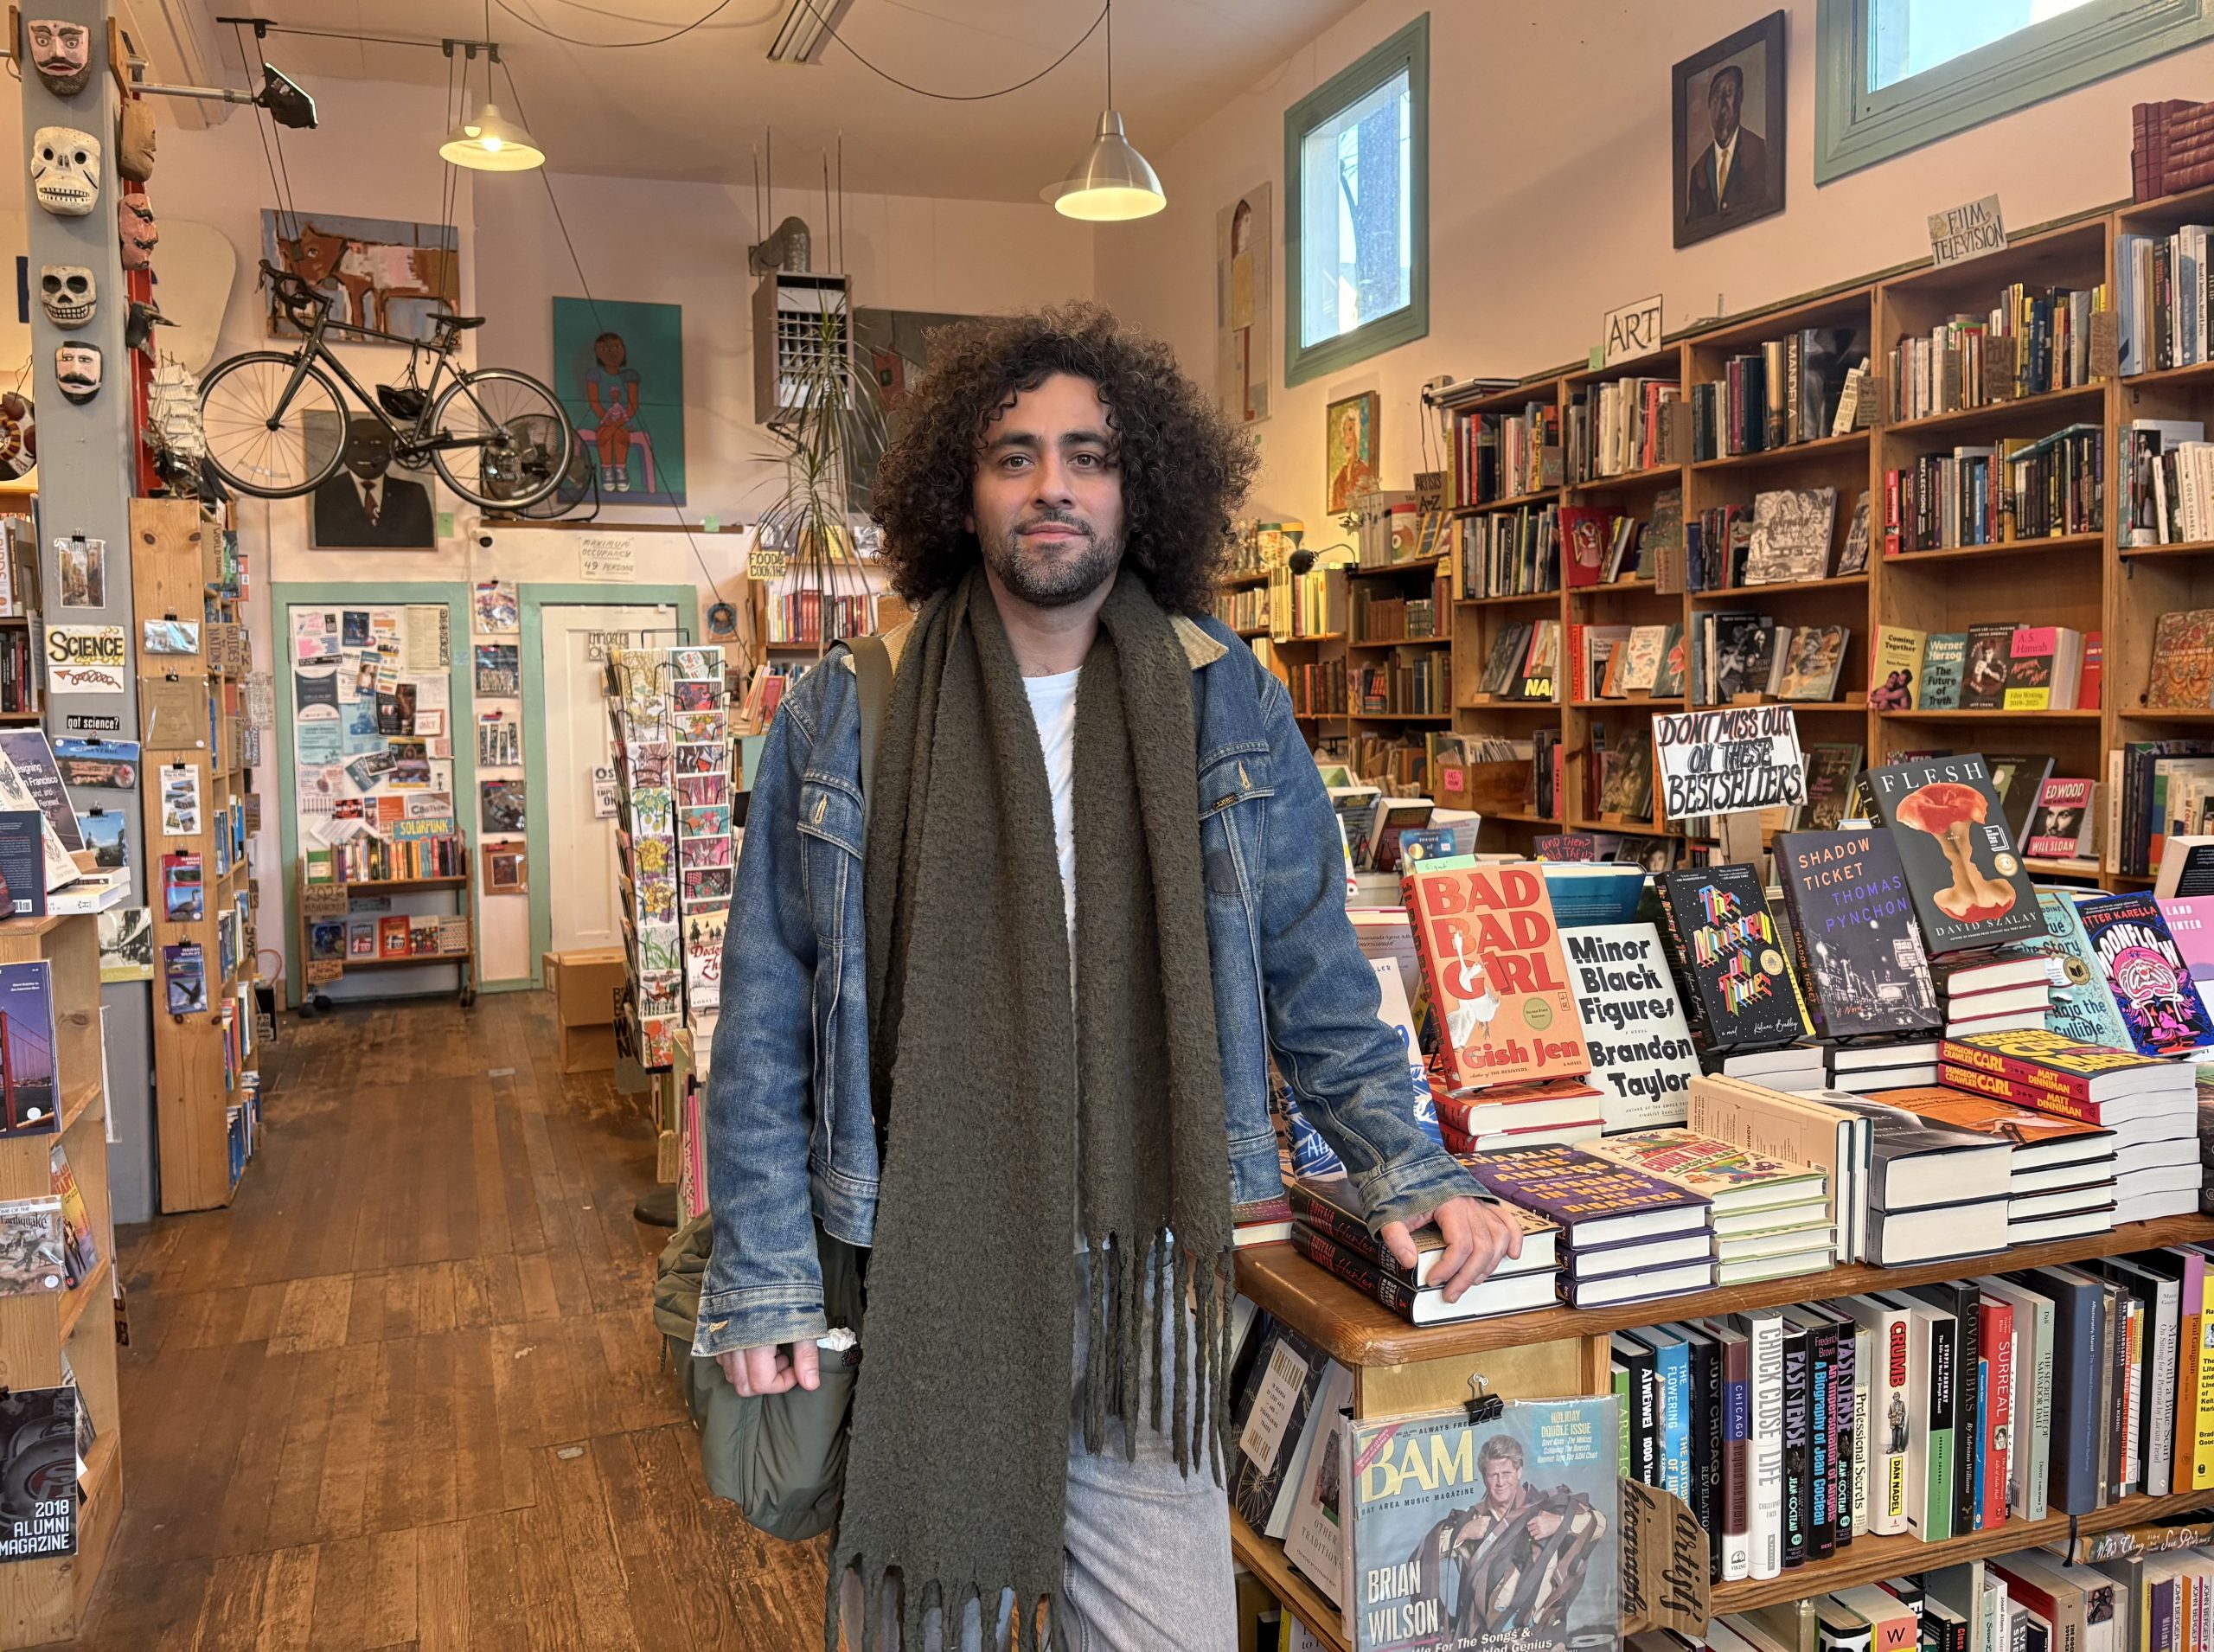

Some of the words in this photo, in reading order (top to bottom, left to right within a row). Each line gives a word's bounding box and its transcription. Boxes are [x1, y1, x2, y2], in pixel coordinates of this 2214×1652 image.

[1948, 202, 1987, 235] FILM
[1932, 215, 2005, 265] TELEVISION
[1608, 306, 1660, 357] ART
[1788, 343, 1797, 419] MANDELA
[581, 548, 631, 559] OCCUPANCY
[582, 539, 630, 548] MAXIMUM
[585, 560, 598, 571] 49
[749, 553, 777, 566] FOOD
[49, 631, 124, 662] SCIENCE
[1885, 642, 1916, 653] Together
[1888, 635, 1916, 645] Coming
[1929, 641, 1965, 652] Werner
[1929, 650, 1962, 663] Herzog
[1936, 666, 1952, 677] The
[1928, 676, 1956, 687] Future
[1936, 686, 1946, 695] of
[1929, 695, 1953, 706] Truth
[67, 717, 82, 730] got
[84, 717, 119, 730] science?
[1658, 712, 1718, 747] DONT
[1715, 708, 1758, 743] MISS
[1762, 707, 1791, 736] OUT
[1688, 741, 1714, 773] ON
[1718, 735, 1774, 772] THESE
[1668, 764, 1803, 816] BESTSELLERS
[1880, 761, 1984, 794] FLESH
[2057, 782, 2085, 797] WOOD
[1798, 836, 1870, 869] SHADOW
[2032, 842, 2049, 852] WILL
[2051, 841, 2075, 851] SLOAN
[1803, 862, 1863, 892] TICKET
[1832, 874, 1903, 906] THOMAS
[1421, 869, 1540, 917] BAD
[1698, 884, 1742, 928] The
[1825, 897, 1908, 933] PYNCHON
[1935, 921, 1980, 937] DAVID
[1987, 912, 2038, 928] SZALAY
[2115, 906, 2158, 920] KARELLA
[2166, 905, 2192, 916] LAND
[1430, 910, 1551, 958] BAD
[1692, 910, 1773, 969] Ministry
[2043, 939, 2082, 957] Story
[1566, 936, 1650, 964] Minor
[1442, 951, 1565, 1001] GIRL
[1579, 963, 1663, 994] Black
[1795, 931, 1808, 969] SHADOW
[1804, 973, 1817, 1003] TICKET
[1578, 997, 1675, 1031] Figures
[2084, 999, 2107, 1015] the
[1462, 1039, 1529, 1069] Gish
[1533, 1038, 1581, 1066] Jen
[1586, 1034, 1694, 1067] Brandon
[1942, 1048, 1974, 1064] CRAWLER
[1943, 1041, 1974, 1057] DUNGEON
[1973, 1050, 2006, 1073] CARL
[1606, 1068, 1692, 1103] Taylor
[2028, 1074, 2070, 1094] DINNIMAN
[2036, 1068, 2058, 1082] MATT
[1458, 1148, 1572, 1166] CHARLIE
[1494, 1162, 1610, 1182] ANDERS
[1496, 1157, 1571, 1172] JANE
[1641, 1149, 1689, 1173] CHUCK
[1688, 1140, 1735, 1162] TINGLE
[1667, 1156, 1712, 1175] LUCKY
[1712, 1149, 1739, 1162] DAY
[1520, 1173, 1635, 1193] LESSONS
[1572, 1180, 1652, 1196] MAGIC
[1591, 1190, 1630, 1201] AND
[1562, 1191, 1685, 1213] DISASTER
[1335, 1258, 1377, 1293] Hunter
[1757, 1327, 1782, 1384] CHUCK
[1818, 1347, 1836, 1358] Brown
[1889, 1320, 1907, 1388] CRUMB
[1965, 1302, 1979, 1412] COVARRUBIAS
[1270, 1347, 1303, 1393] CRAFTLAND
[1680, 1362, 1688, 1386] THE
[1710, 1356, 1719, 1399] JUDY
[1786, 1350, 1806, 1390] PAST
[1996, 1341, 2011, 1418] SURREAL
[1667, 1366, 1678, 1429] FLOWERING
[1757, 1386, 1782, 1438] CLOSE
[1813, 1371, 1827, 1431] Biography
[1418, 1424, 1449, 1435] ALWAYS
[1541, 1424, 1569, 1437] DOUBLE
[1570, 1422, 1591, 1436] ISSUE
[1551, 1410, 1581, 1424] HOLIDAY
[1618, 1407, 1629, 1440] ART
[1786, 1395, 1806, 1449] TENSE
[1827, 1380, 1837, 1463] Impersonation
[1855, 1393, 1867, 1466] Professional
[1710, 1405, 1720, 1486] CHICAGO
[1813, 1444, 1826, 1476] Jean
[1360, 1428, 1475, 1503] BAM
[1732, 1444, 1745, 1480] beyond
[1757, 1451, 1782, 1487] LIFE
[1891, 1459, 1901, 1479] DAN
[1379, 1502, 1400, 1511] AREA
[1404, 1496, 1430, 1507] MUSIC
[1434, 1487, 1475, 1502] MAGAZINE
[1813, 1477, 1826, 1526] Cocteau
[1827, 1481, 1837, 1522] Angels
[1854, 1467, 1866, 1510] Secrets
[1891, 1482, 1901, 1512] NADEL
[35, 1499, 69, 1518] 2018
[1732, 1498, 1745, 1528] flower
[14, 1516, 69, 1538] ALUMNI
[1313, 1518, 1338, 1546] OTHER
[0, 1534, 69, 1557] MAGAZINE
[1300, 1525, 1342, 1571] TRADITIONS
[1623, 1478, 1656, 1617] biography
[2096, 1538, 2117, 1559] Wild
[2121, 1534, 2145, 1556] Thing
[2178, 1527, 2211, 1549] Prideaux
[1367, 1559, 1422, 1605] BRIAN
[1368, 1598, 1439, 1646] WILSON
[1481, 1629, 1519, 1643] Songs
[1457, 1636, 1477, 1649] The
[1512, 1637, 1553, 1652] Genius
